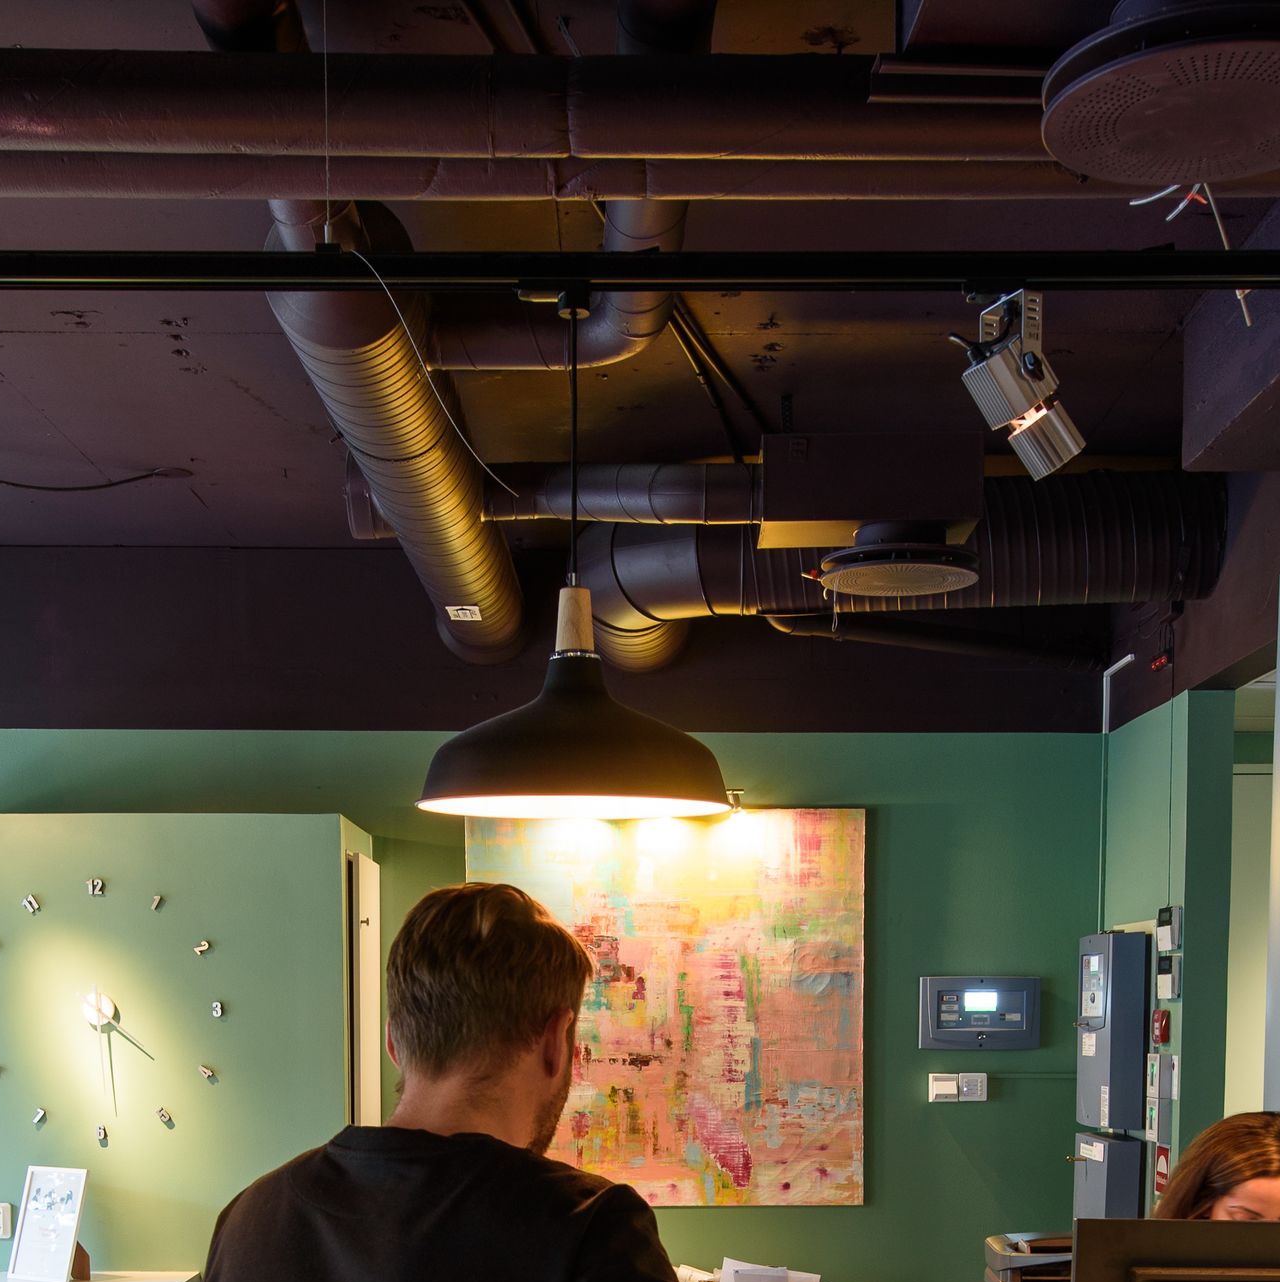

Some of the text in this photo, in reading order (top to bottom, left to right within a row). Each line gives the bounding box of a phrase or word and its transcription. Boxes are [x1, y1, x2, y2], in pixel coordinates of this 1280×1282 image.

[85, 878, 104, 895] 12
[22, 893, 40, 913] 11
[151, 895, 161, 911] 1
[193, 940, 210, 955] 2
[212, 1001, 223, 1018] 3
[198, 1065, 214, 1079] 4
[32, 1108, 46, 1124] 7
[156, 1107, 171, 1123] 5
[96, 1125, 106, 1140] 6
